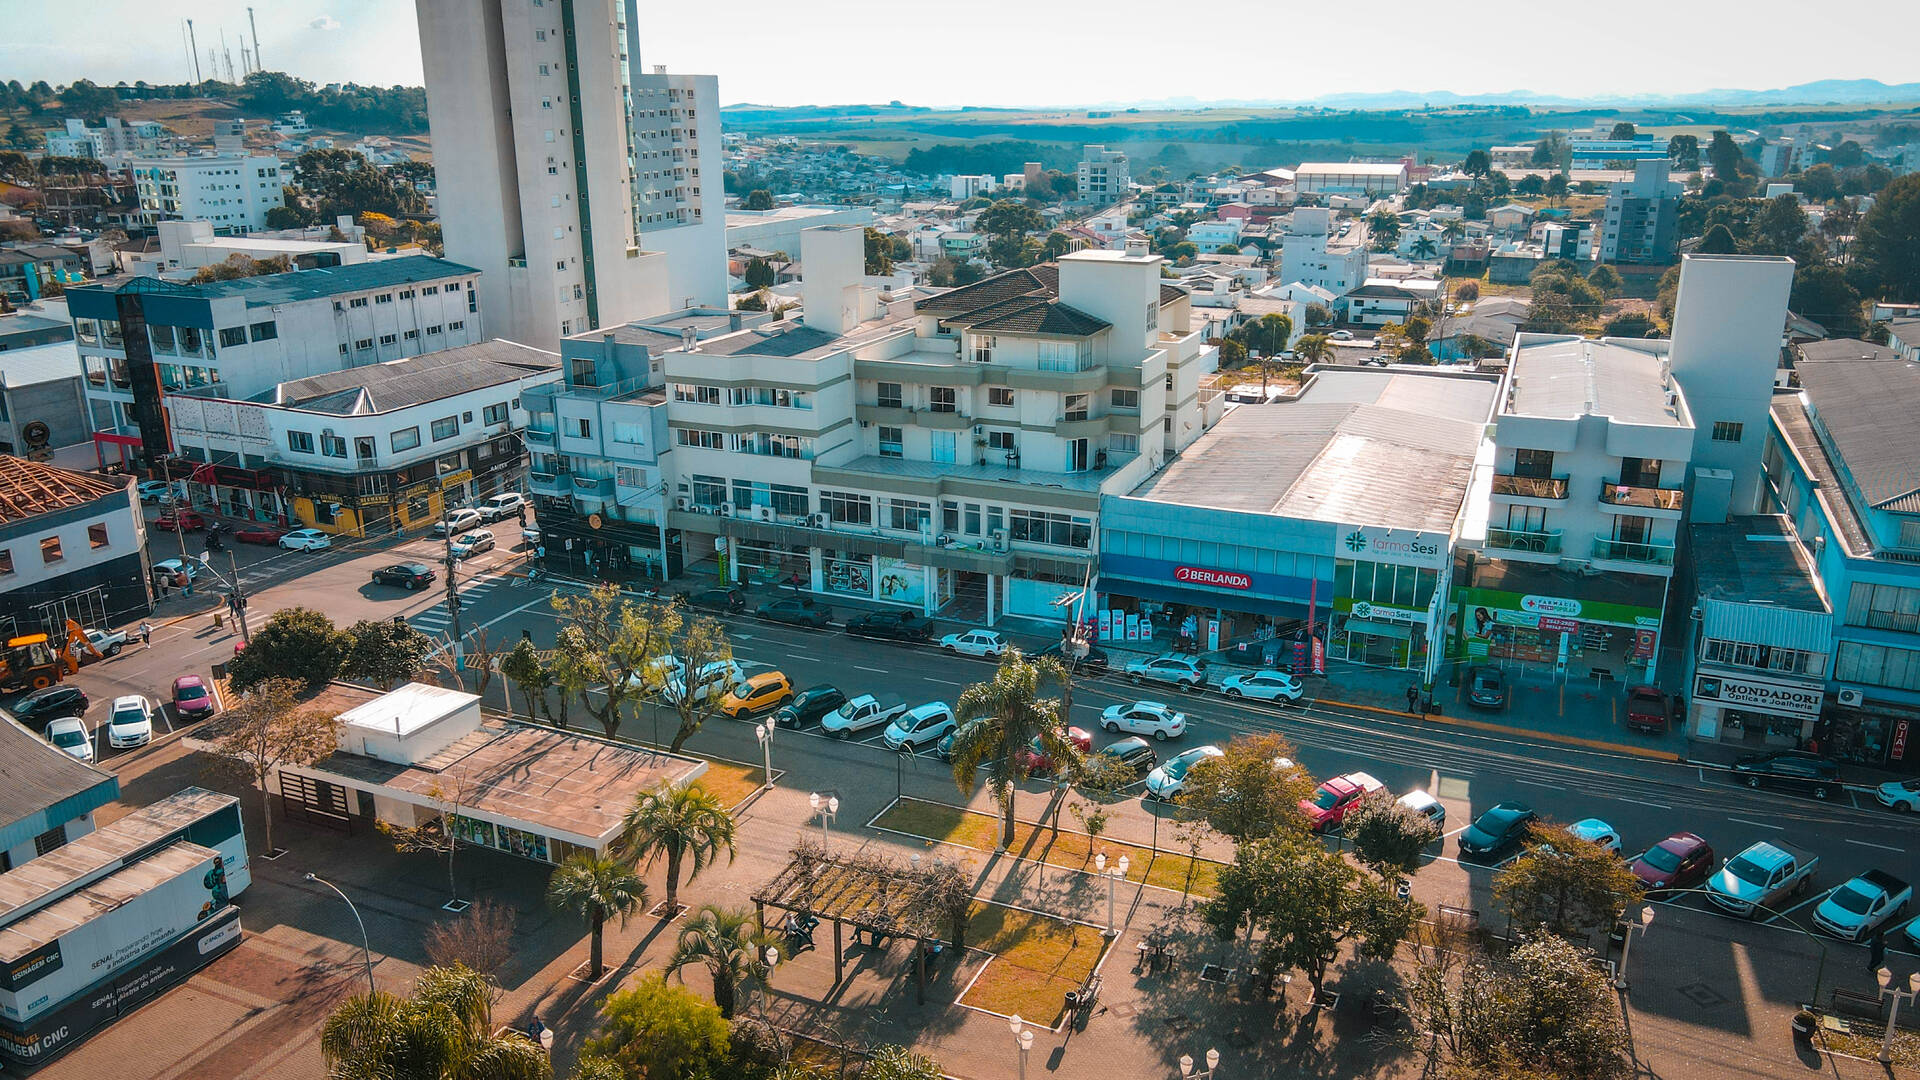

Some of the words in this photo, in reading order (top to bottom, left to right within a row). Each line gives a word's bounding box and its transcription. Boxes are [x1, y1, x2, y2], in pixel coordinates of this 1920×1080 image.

[1373, 538, 1438, 555] farmaSesi
[1190, 570, 1248, 587] BERLANDA
[1724, 684, 1820, 704] MONDADORI
[1769, 699, 1812, 710] Joalheria
[46, 952, 59, 963] CNC
[43, 1025, 69, 1048] CNC
